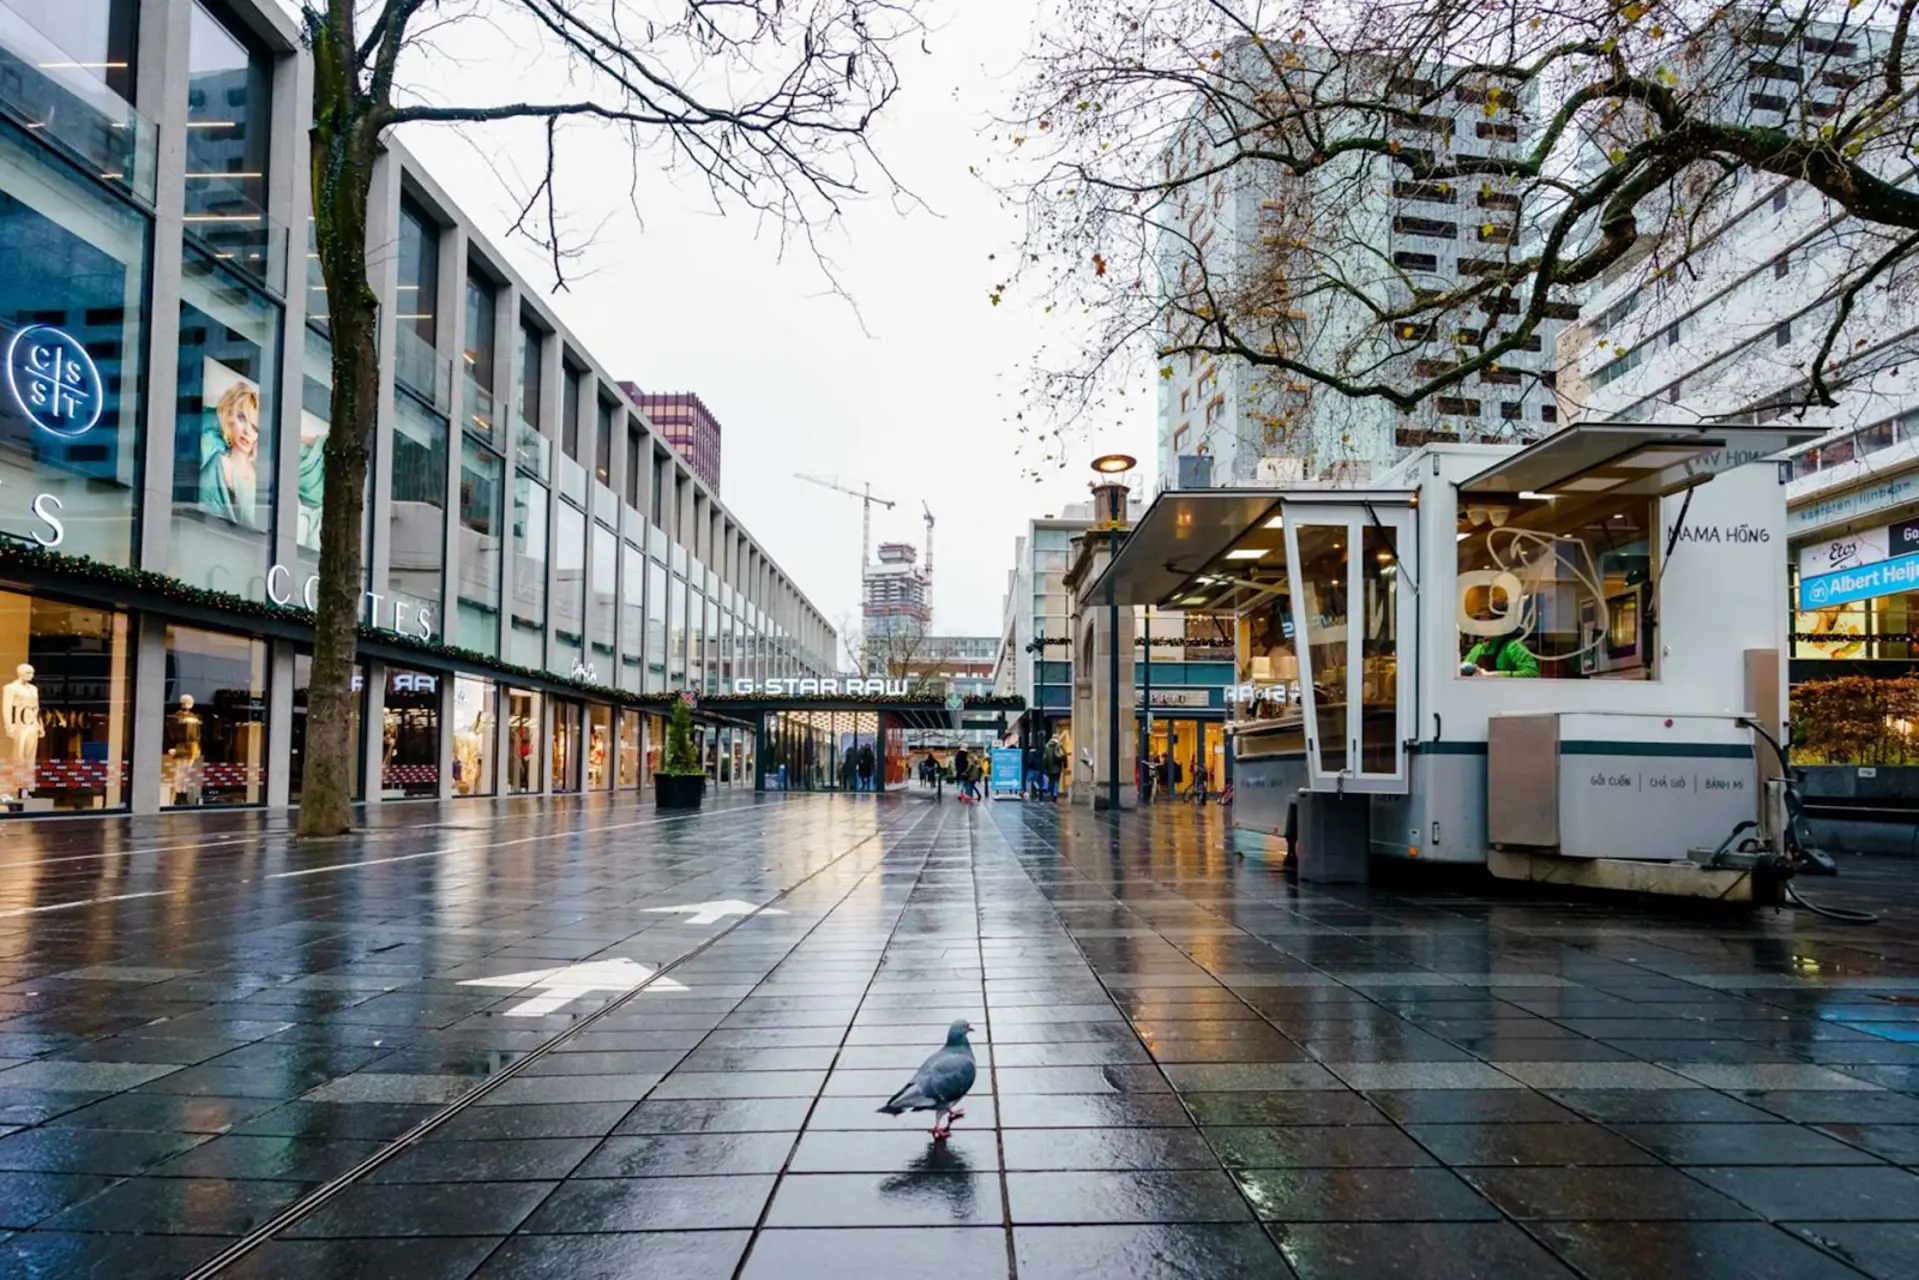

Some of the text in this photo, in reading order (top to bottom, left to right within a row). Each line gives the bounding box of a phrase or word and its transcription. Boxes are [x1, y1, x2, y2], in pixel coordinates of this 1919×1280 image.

[1829, 541, 1857, 561] Etos
[1830, 570, 1880, 595] Albert
[1883, 560, 1919, 585] Heij
[735, 678, 908, 697] G-STAR RAW
